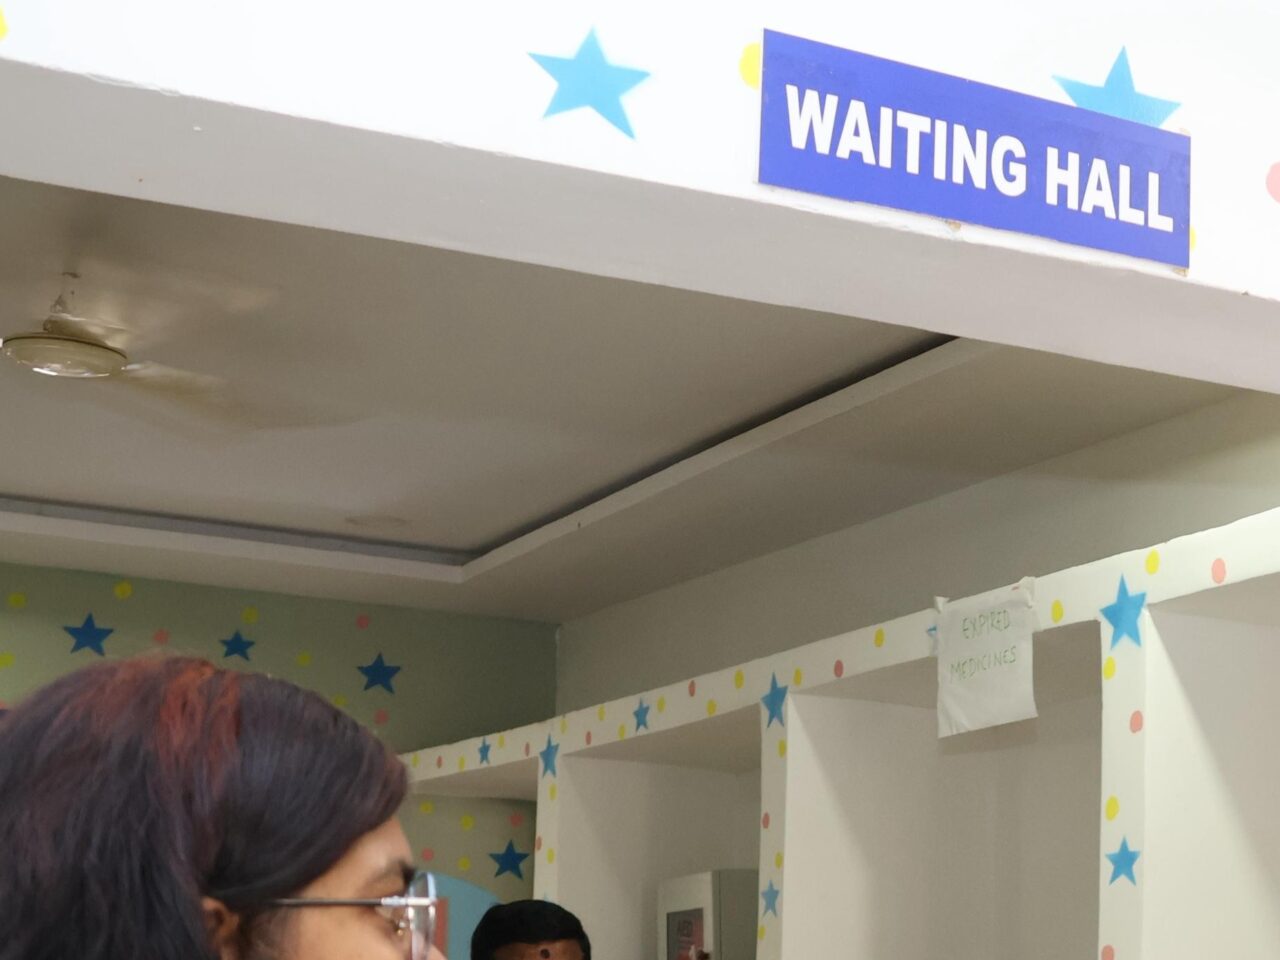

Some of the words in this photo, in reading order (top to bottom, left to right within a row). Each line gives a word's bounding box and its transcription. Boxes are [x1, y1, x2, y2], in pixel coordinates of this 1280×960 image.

[785, 83, 1027, 197] WAITING
[1045, 146, 1174, 233] HALL
[962, 609, 1010, 639] EXPIRED
[950, 645, 1017, 681] MEDICINES
